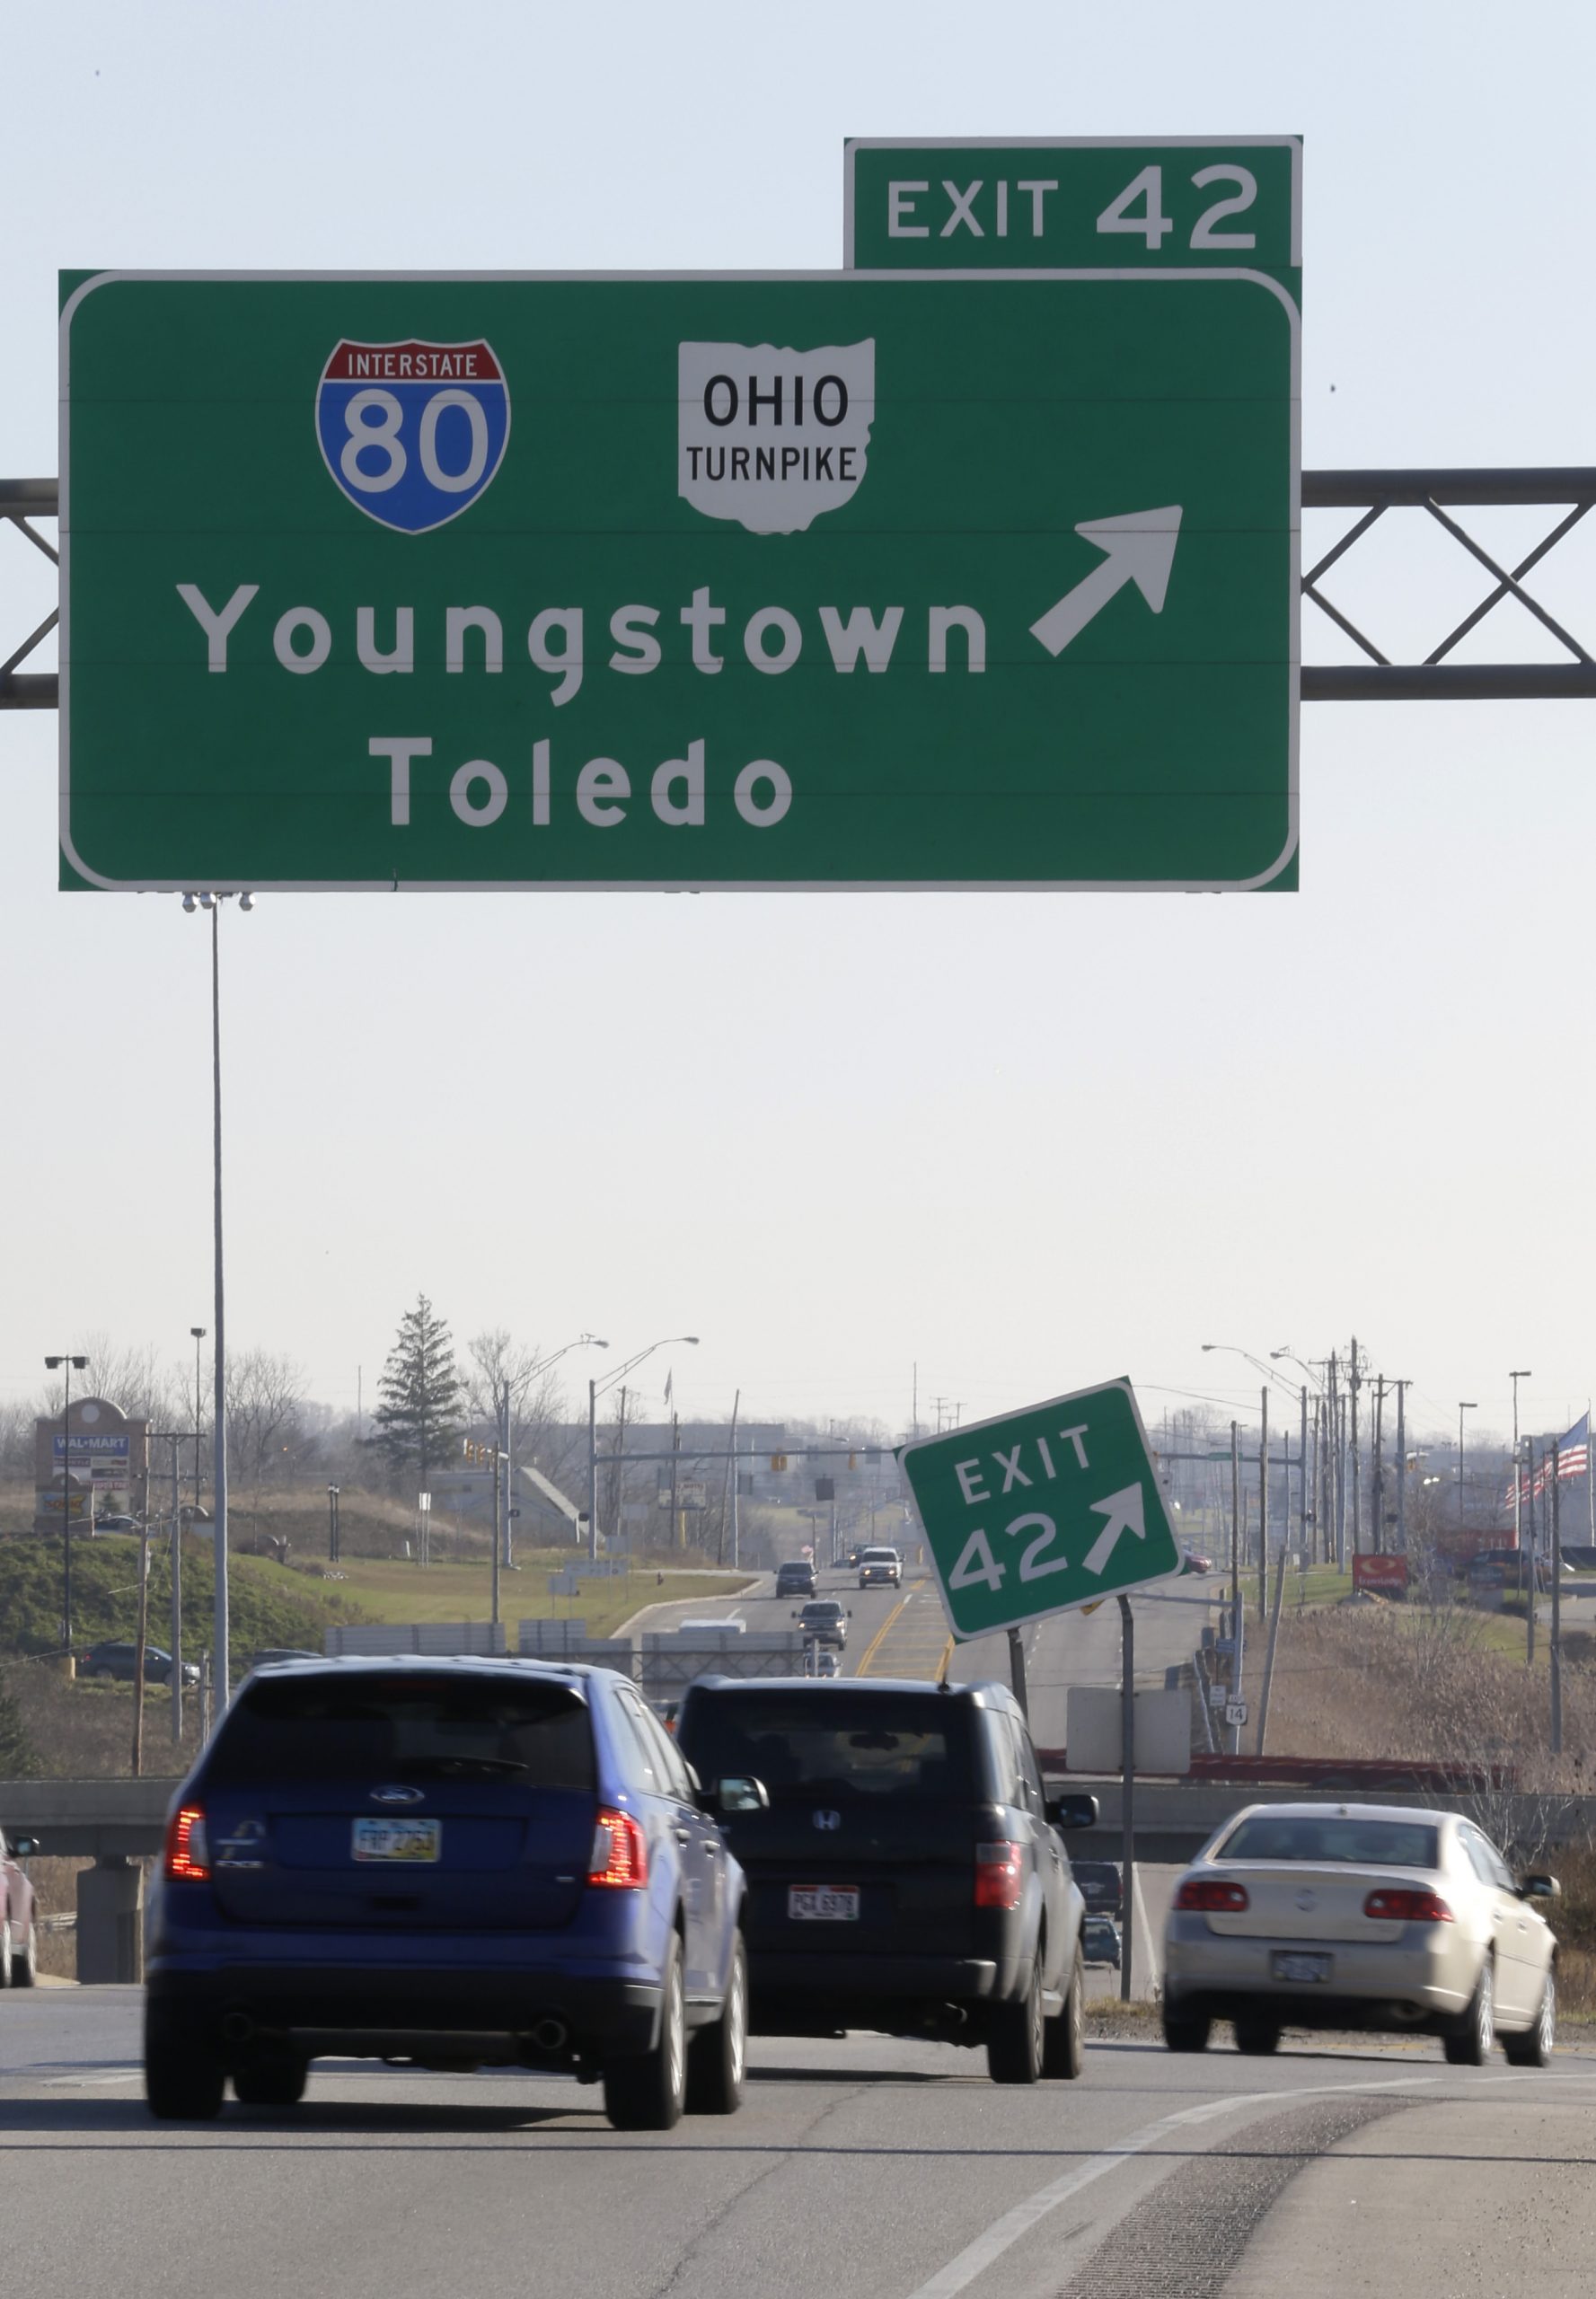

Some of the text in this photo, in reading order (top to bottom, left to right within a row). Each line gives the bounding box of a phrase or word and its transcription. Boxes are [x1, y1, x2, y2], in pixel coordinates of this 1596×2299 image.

[887, 163, 1258, 250] EXIT 42
[347, 353, 479, 377] INTERSTATE
[702, 374, 849, 427] OHIO
[340, 388, 489, 493] 80
[685, 445, 859, 482] TURNPIKE
[176, 584, 988, 709] Youngstown
[367, 736, 794, 828] Toledo
[954, 1423, 1089, 1505] EXIT
[948, 1512, 1069, 1592] 42
[1230, 1708, 1243, 1720] 14
